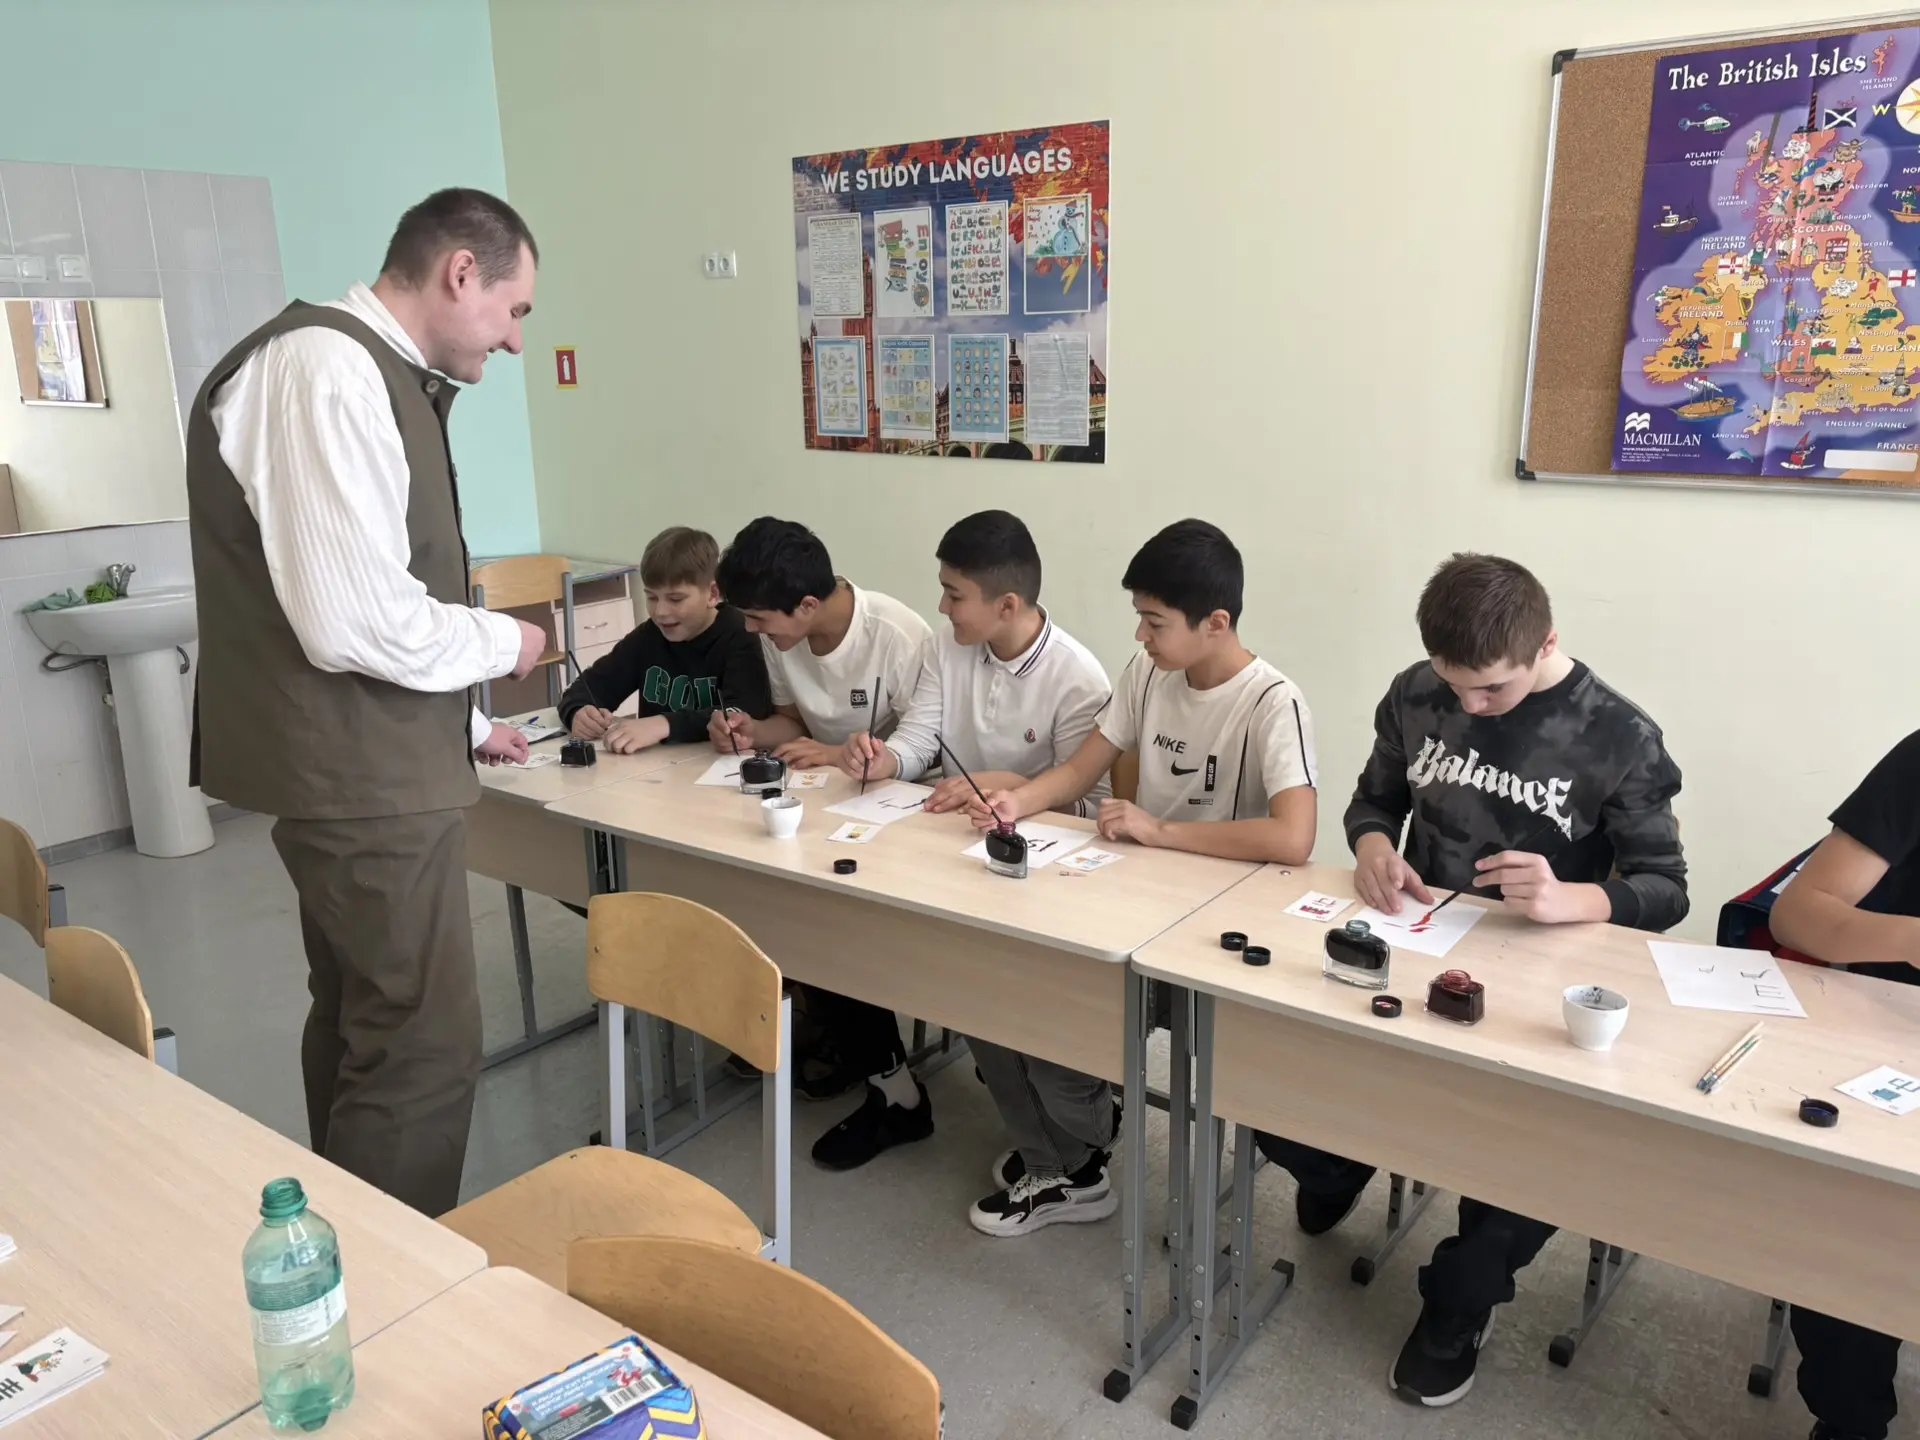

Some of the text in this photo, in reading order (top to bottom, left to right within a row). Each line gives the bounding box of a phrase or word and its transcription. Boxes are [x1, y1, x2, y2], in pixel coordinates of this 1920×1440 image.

[1668, 47, 1867, 90] The British Isles
[1859, 76, 1898, 84] SHETLAND
[1862, 82, 1893, 90] ISLANDS
[1872, 103, 1891, 116] W
[1684, 150, 1726, 159] ATLANTIC
[1690, 159, 1719, 167] OCEAN
[820, 147, 1072, 194] WE STUDY LANGUAGES
[1849, 182, 1889, 190] Aberdeen
[1832, 212, 1872, 221] Edinburgh
[1792, 224, 1852, 234] SCOTLAND
[1701, 242, 1746, 250] IRELAND
[1852, 240, 1894, 248] Newcastle
[1826, 420, 1862, 428] ENGLISH
[1623, 432, 1702, 446] MACMILLAN
[1153, 733, 1187, 754] NIKE
